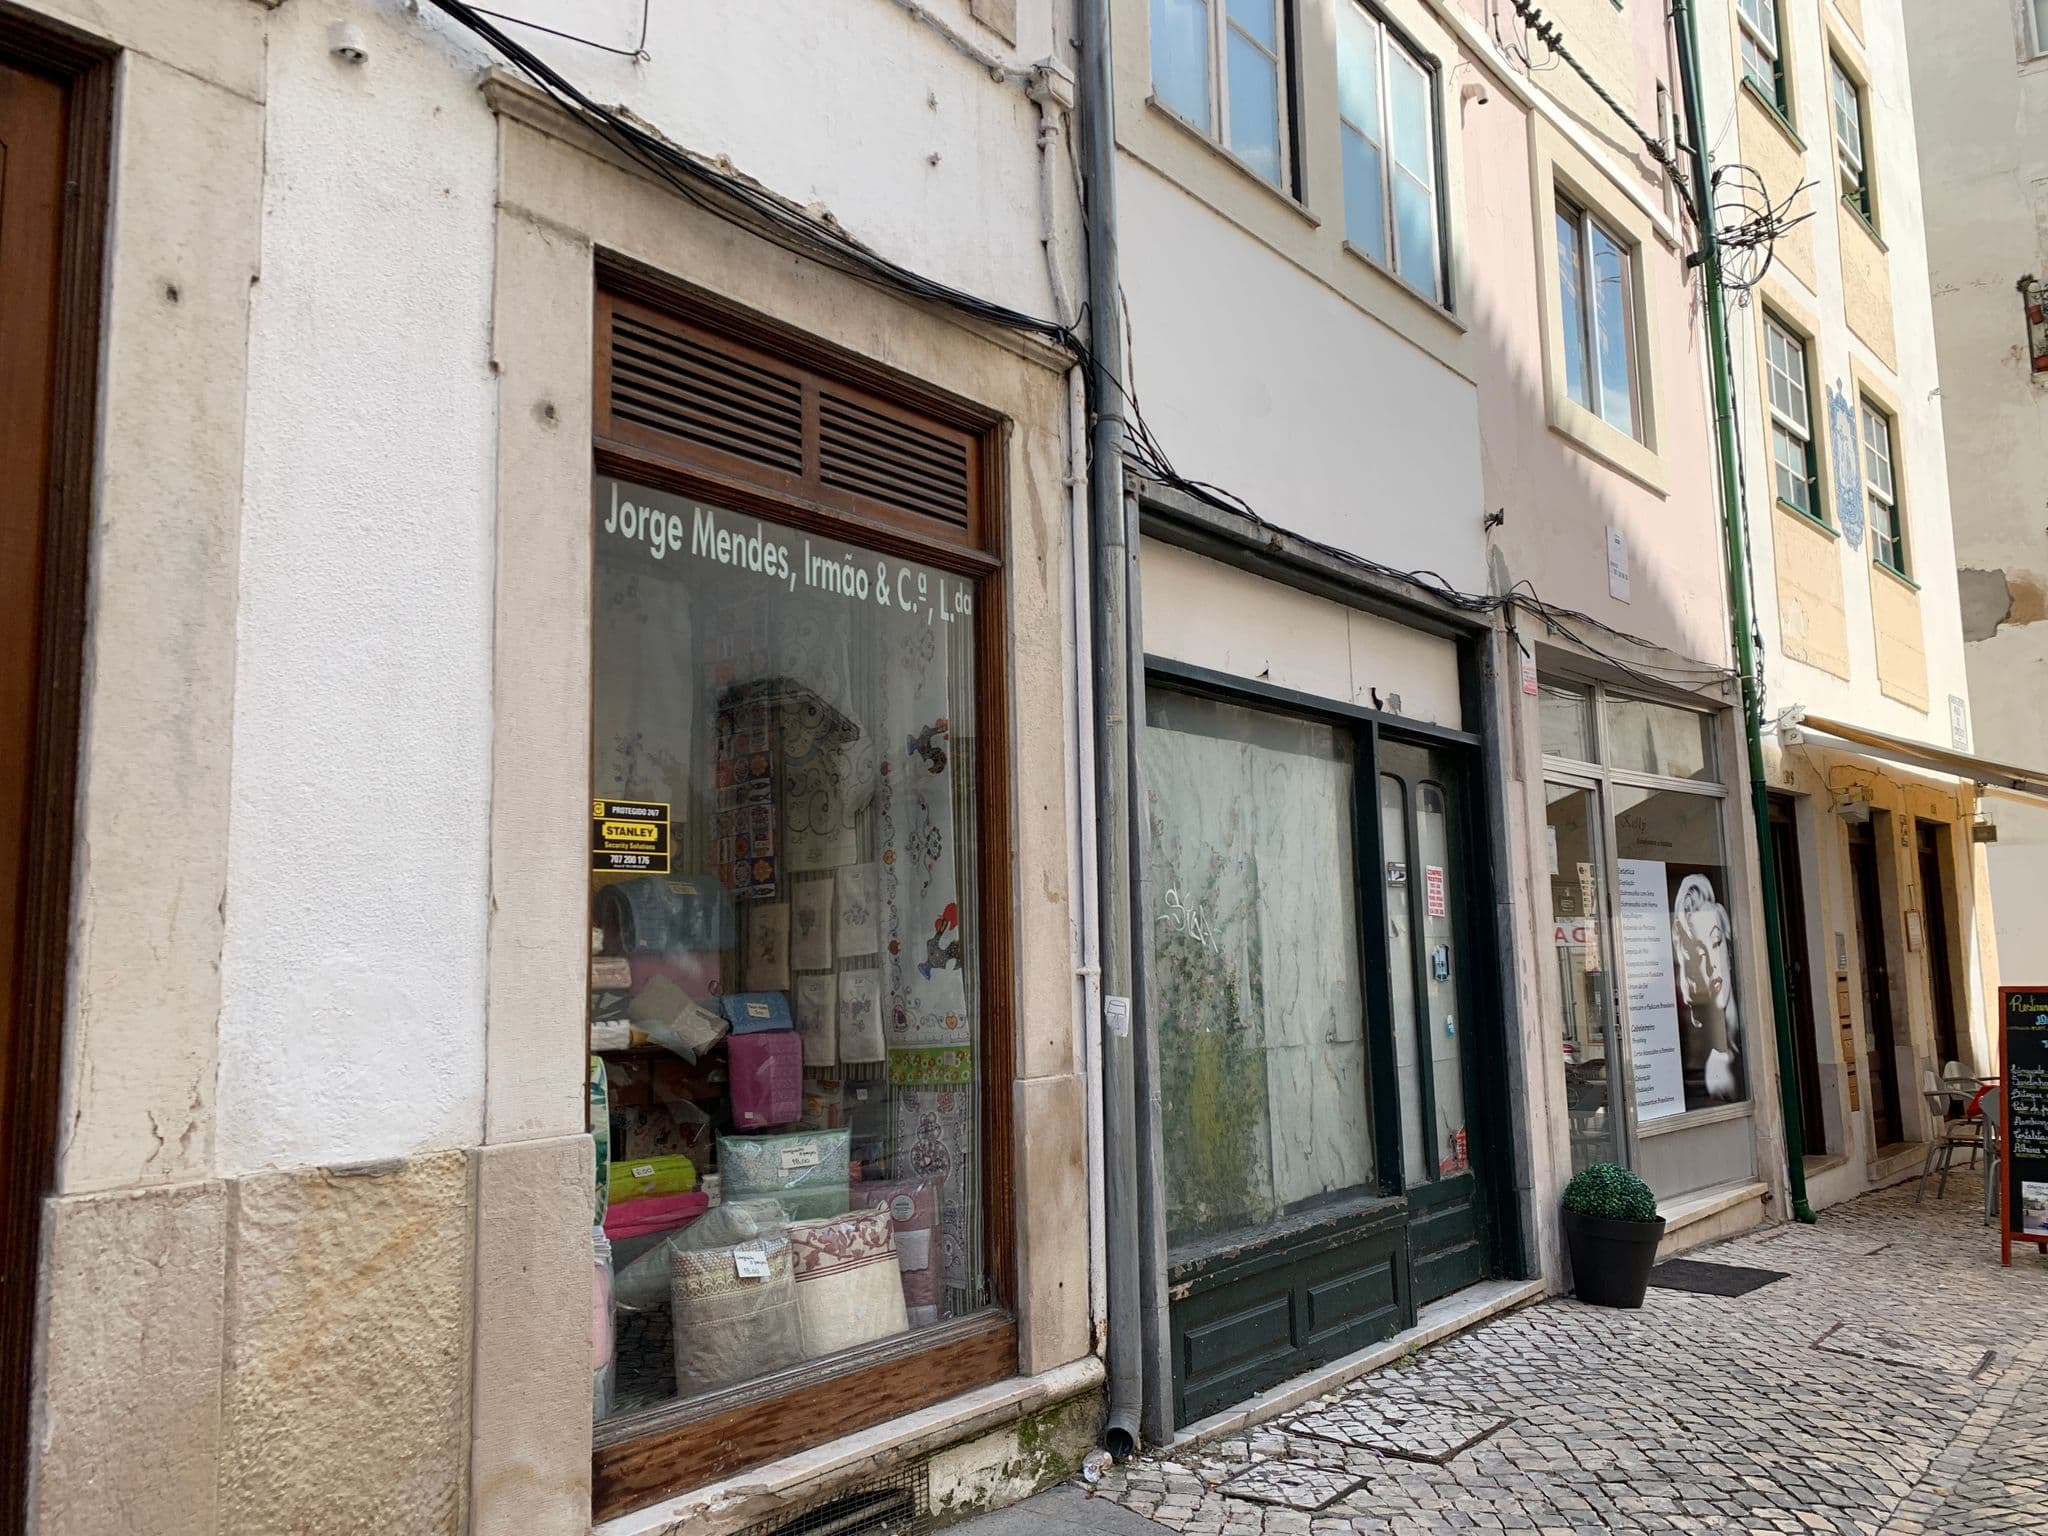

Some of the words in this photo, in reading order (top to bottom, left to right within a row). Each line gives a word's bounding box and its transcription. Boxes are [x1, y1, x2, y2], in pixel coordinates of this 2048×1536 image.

[604, 482, 684, 560] Jorge
[691, 507, 797, 592] Mendes,
[804, 540, 868, 600] Irmão
[876, 561, 891, 606] &
[612, 806, 646, 816] PROTEGIDO
[606, 826, 654, 837] STANLEY
[604, 841, 628, 850] Security
[630, 842, 656, 850] Solutions
[610, 854, 622, 864] 707
[624, 856, 636, 864] 200
